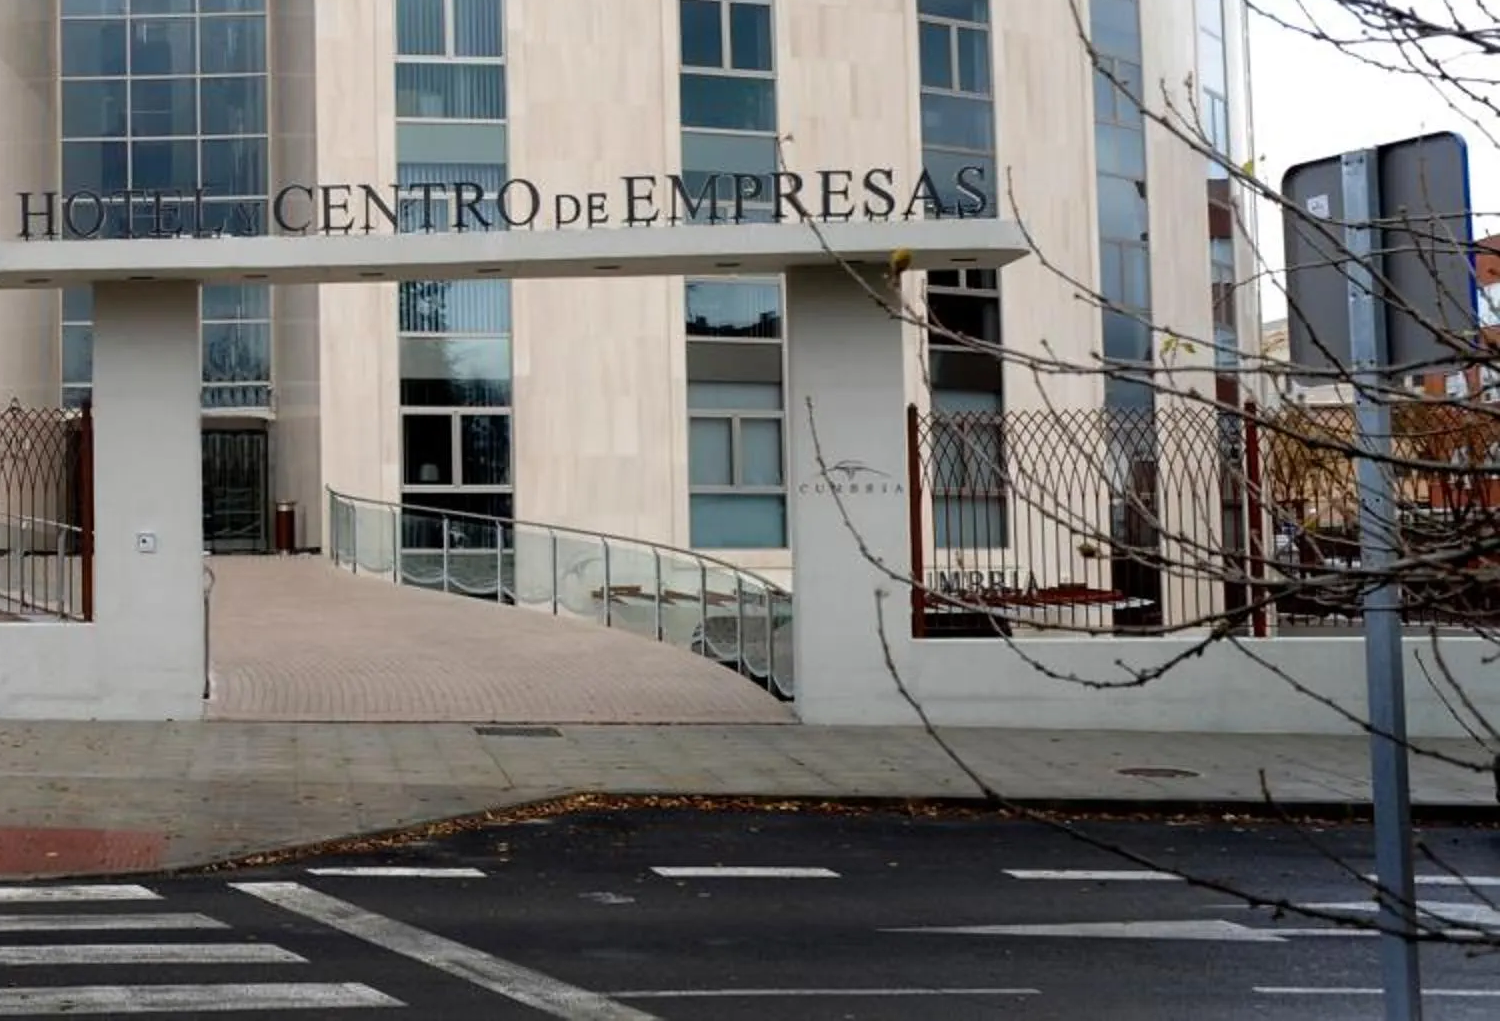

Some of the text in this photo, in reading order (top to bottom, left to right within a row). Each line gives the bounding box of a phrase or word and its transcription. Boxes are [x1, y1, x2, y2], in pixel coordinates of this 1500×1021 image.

[16, 186, 225, 239] HOTEL
[273, 178, 541, 233] CENTRO
[555, 192, 609, 226] DE
[621, 165, 987, 223] EMPRESAS
